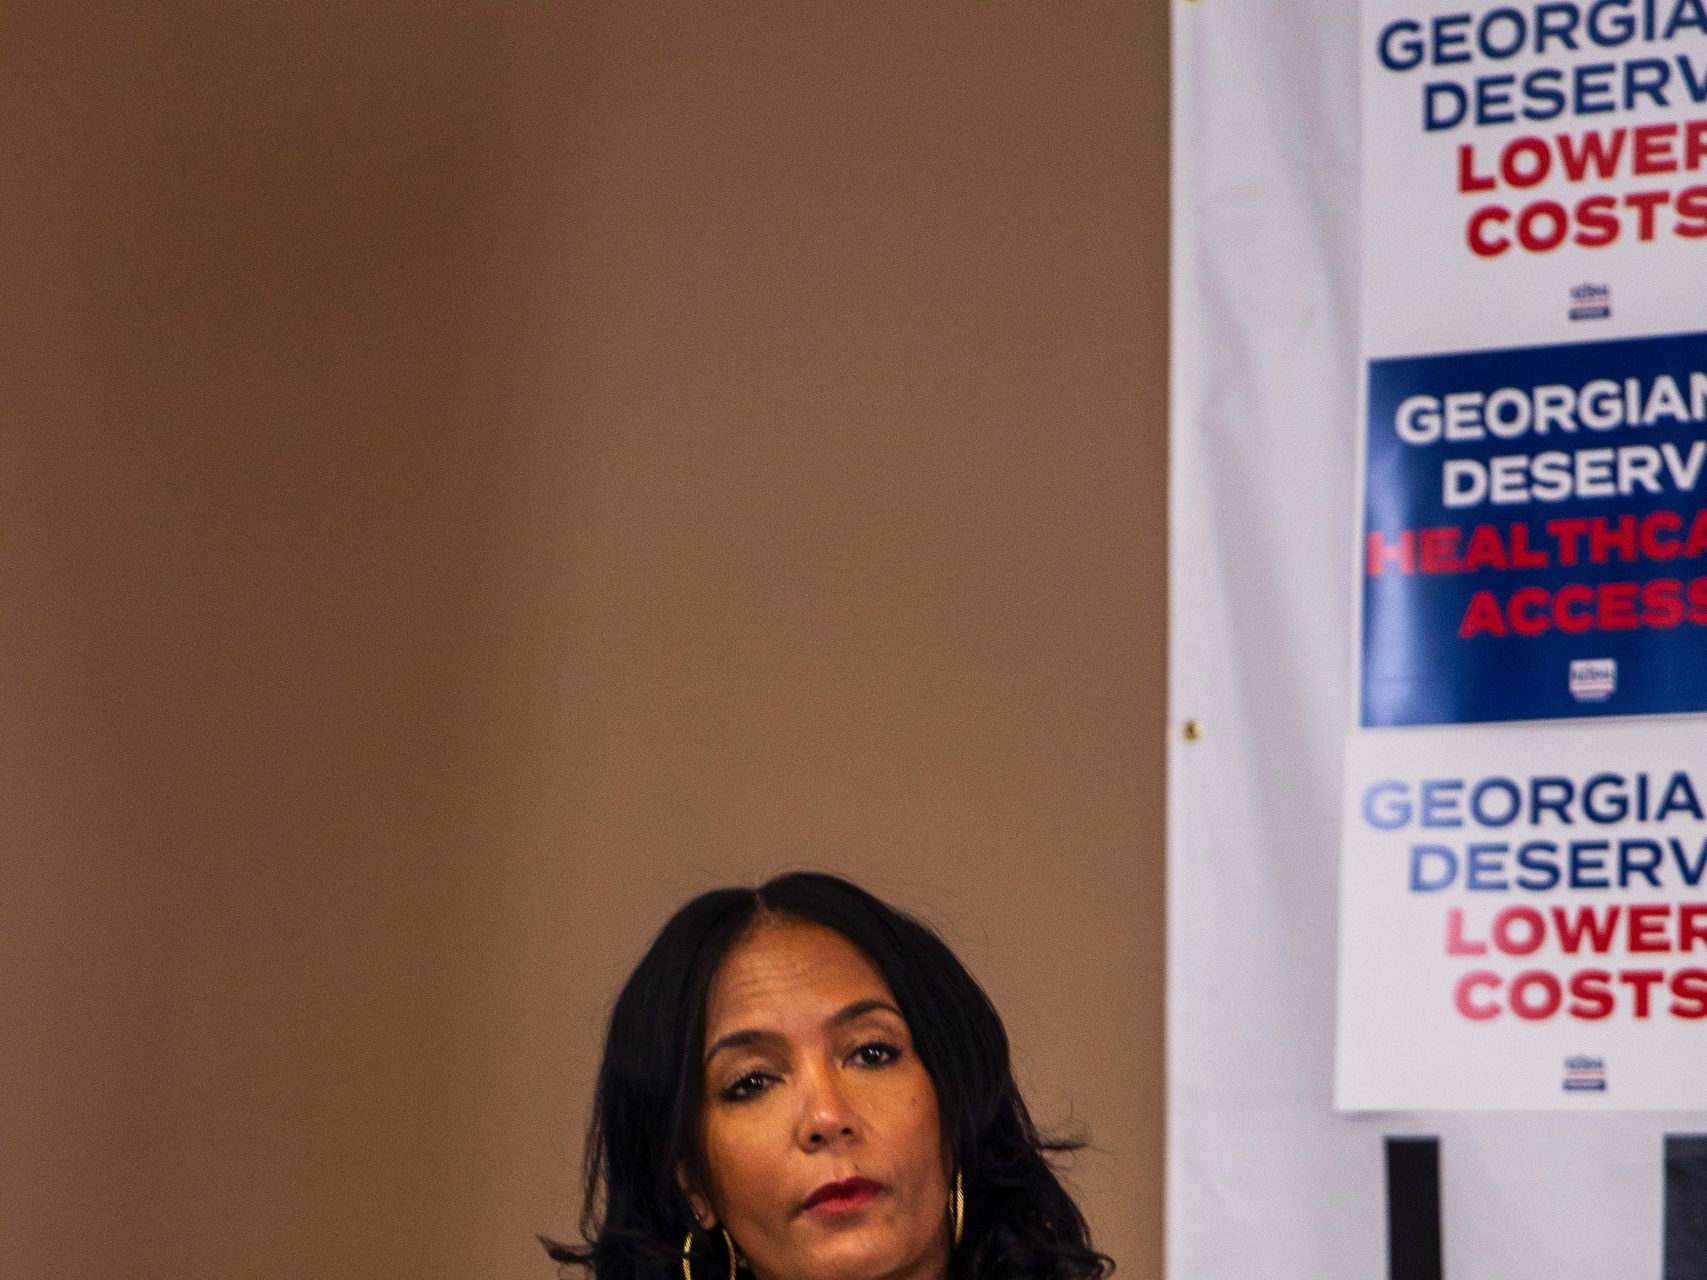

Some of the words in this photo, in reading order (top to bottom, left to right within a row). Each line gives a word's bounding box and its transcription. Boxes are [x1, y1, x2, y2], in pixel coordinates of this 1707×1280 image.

[1377, 0, 1707, 72] GEORGIA
[1422, 54, 1707, 132] DESERV
[1465, 184, 1707, 259] COSTS
[1442, 440, 1707, 508] DESERV
[1361, 771, 1706, 831] GEORGIA
[1408, 836, 1707, 893] DESERV
[1453, 967, 1707, 1021] COSTS
